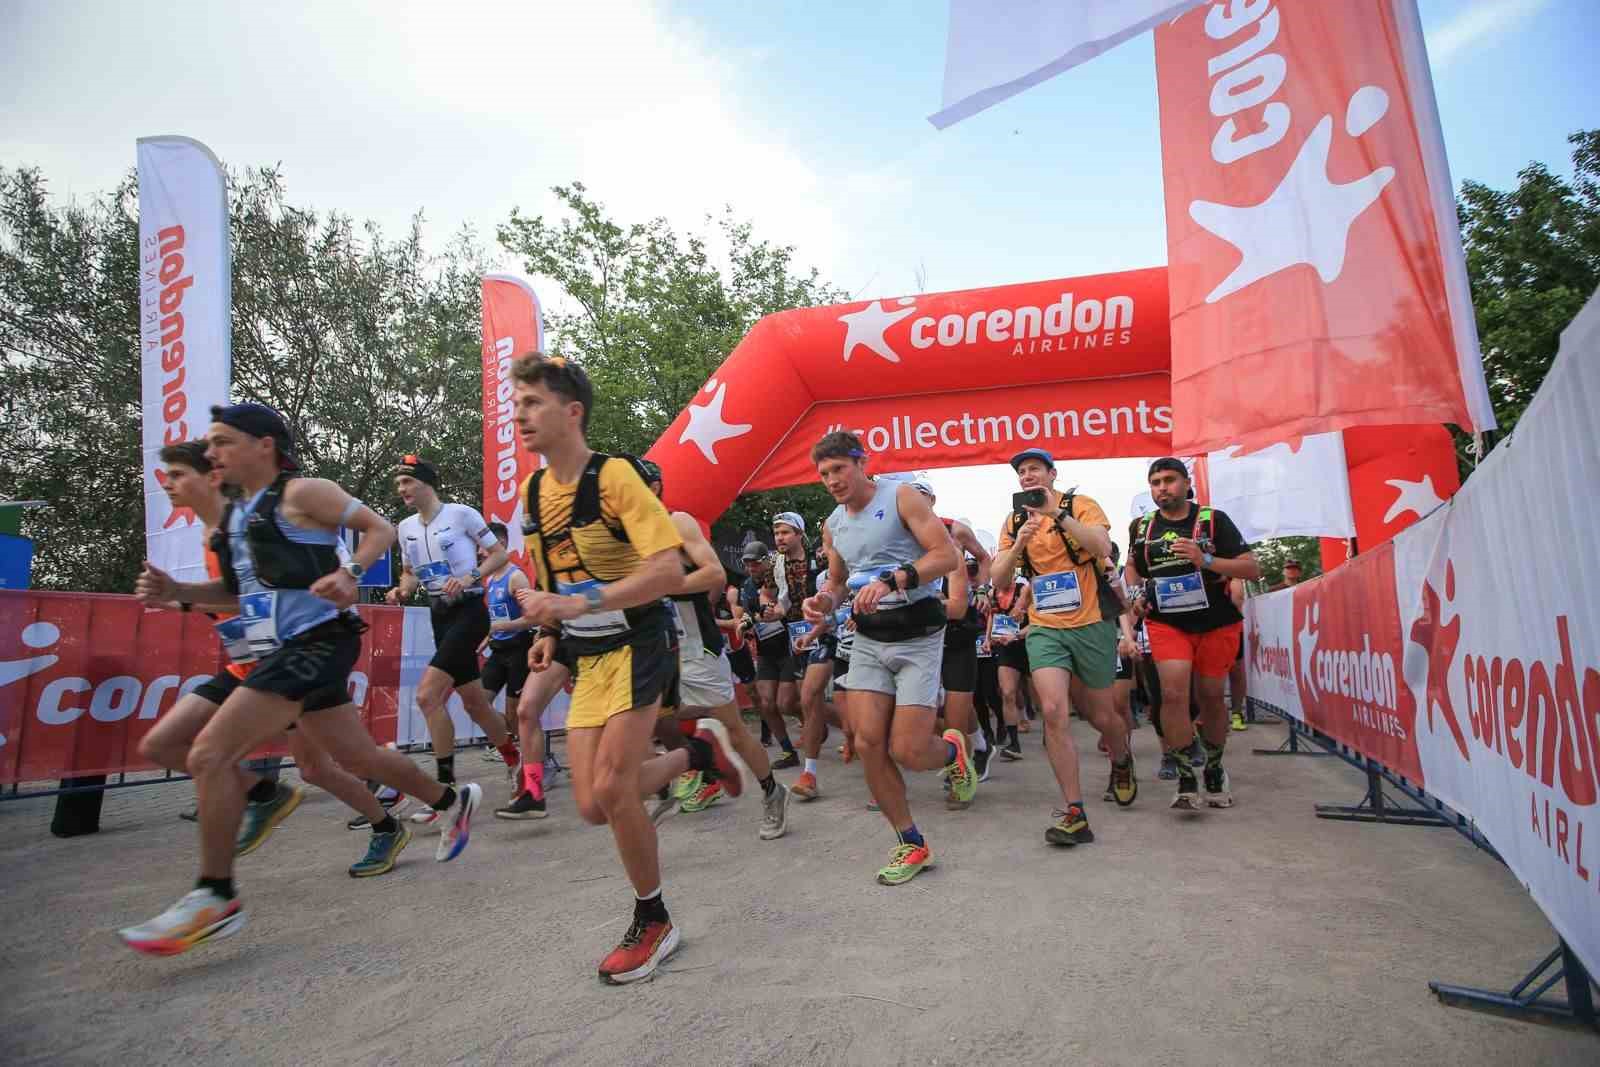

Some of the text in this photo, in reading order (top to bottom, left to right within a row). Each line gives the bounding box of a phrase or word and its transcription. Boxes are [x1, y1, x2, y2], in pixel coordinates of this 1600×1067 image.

[910, 292, 1134, 349] corendon
[1012, 330, 1132, 356] AIRLINES
[822, 399, 1173, 452] ollectmoments
[1316, 633, 1397, 711] corendon
[1352, 703, 1407, 740] AIRLINES
[1531, 792, 1600, 893] AIRL
